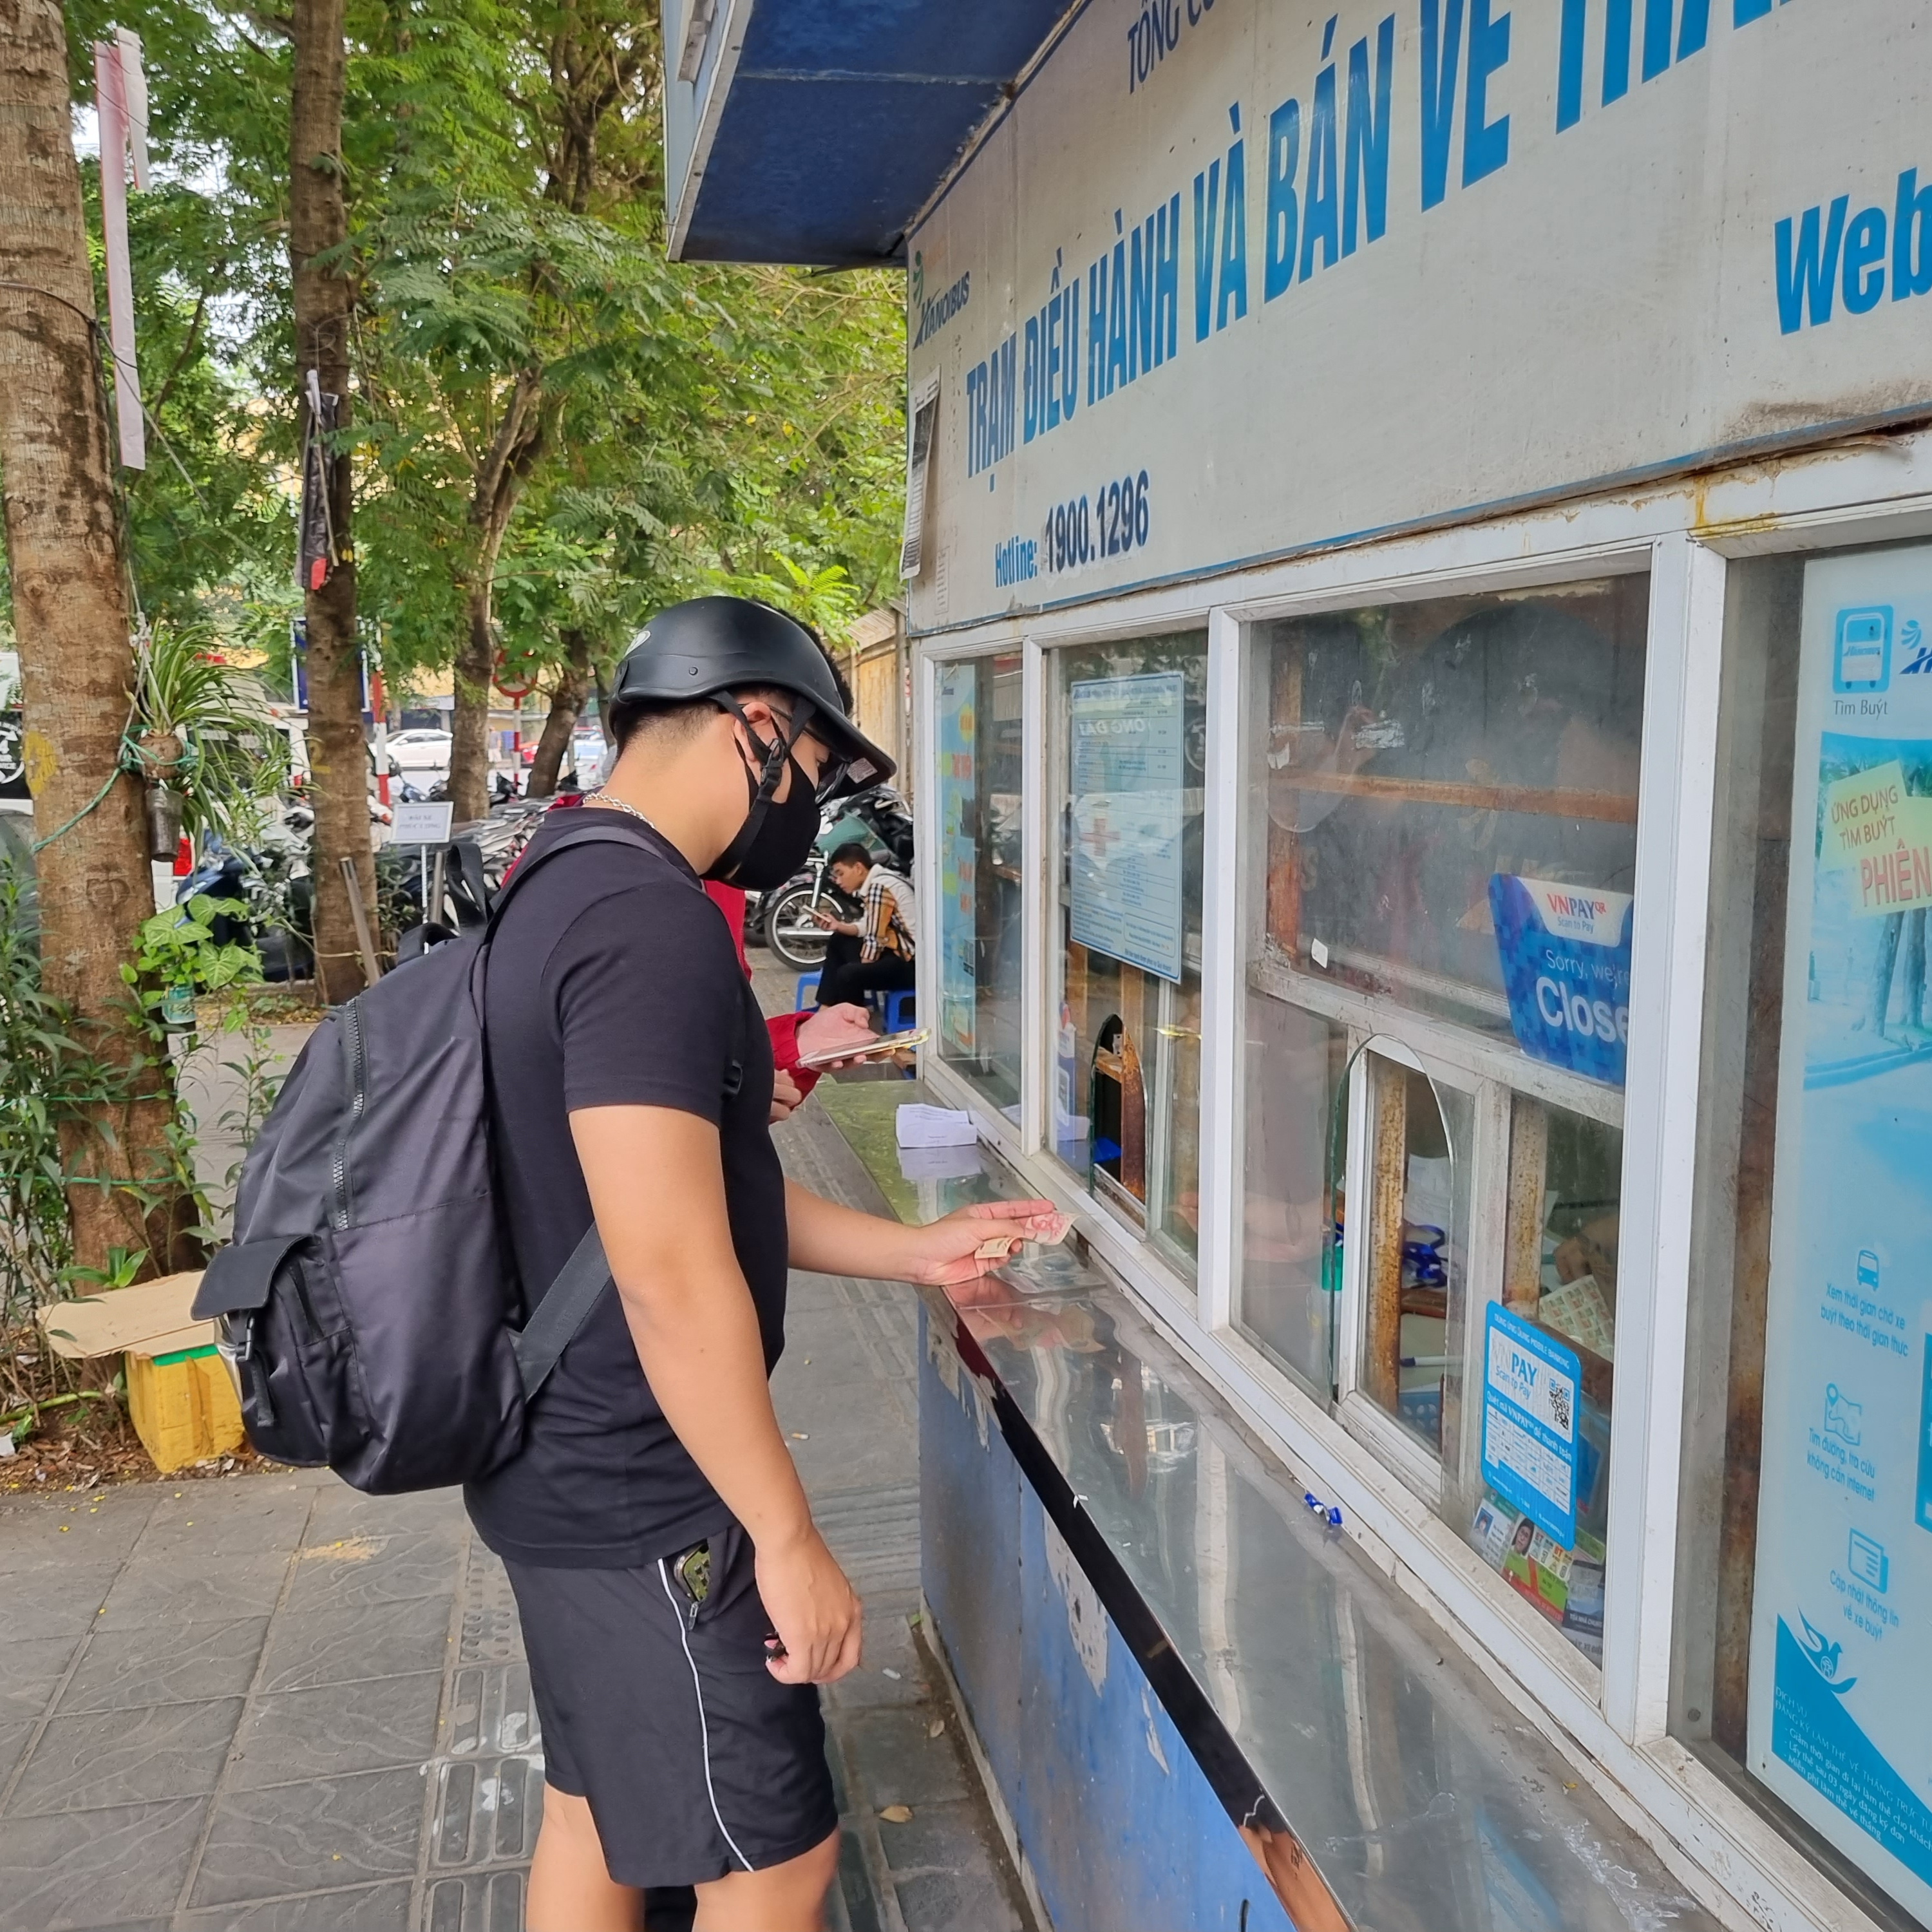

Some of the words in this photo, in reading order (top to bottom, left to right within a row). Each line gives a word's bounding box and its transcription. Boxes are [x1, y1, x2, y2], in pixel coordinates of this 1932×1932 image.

[967, 330, 1017, 493] TRẠM
[1023, 247, 1080, 445] ĐIỀU
[1087, 191, 1180, 408] HÀNH
[1193, 100, 1247, 344] VÀ
[1264, 12, 1396, 305] BÁN
[995, 535, 1037, 588] Hotline:
[1045, 469, 1150, 574] 1900.1296
[1861, 698, 1888, 721] Buýt
[1861, 784, 1899, 815] DỤNG
[1864, 815, 1895, 844] BUÝT
[1861, 837, 1932, 907] PHIÊN
[1546, 949, 1588, 980] Sorry,
